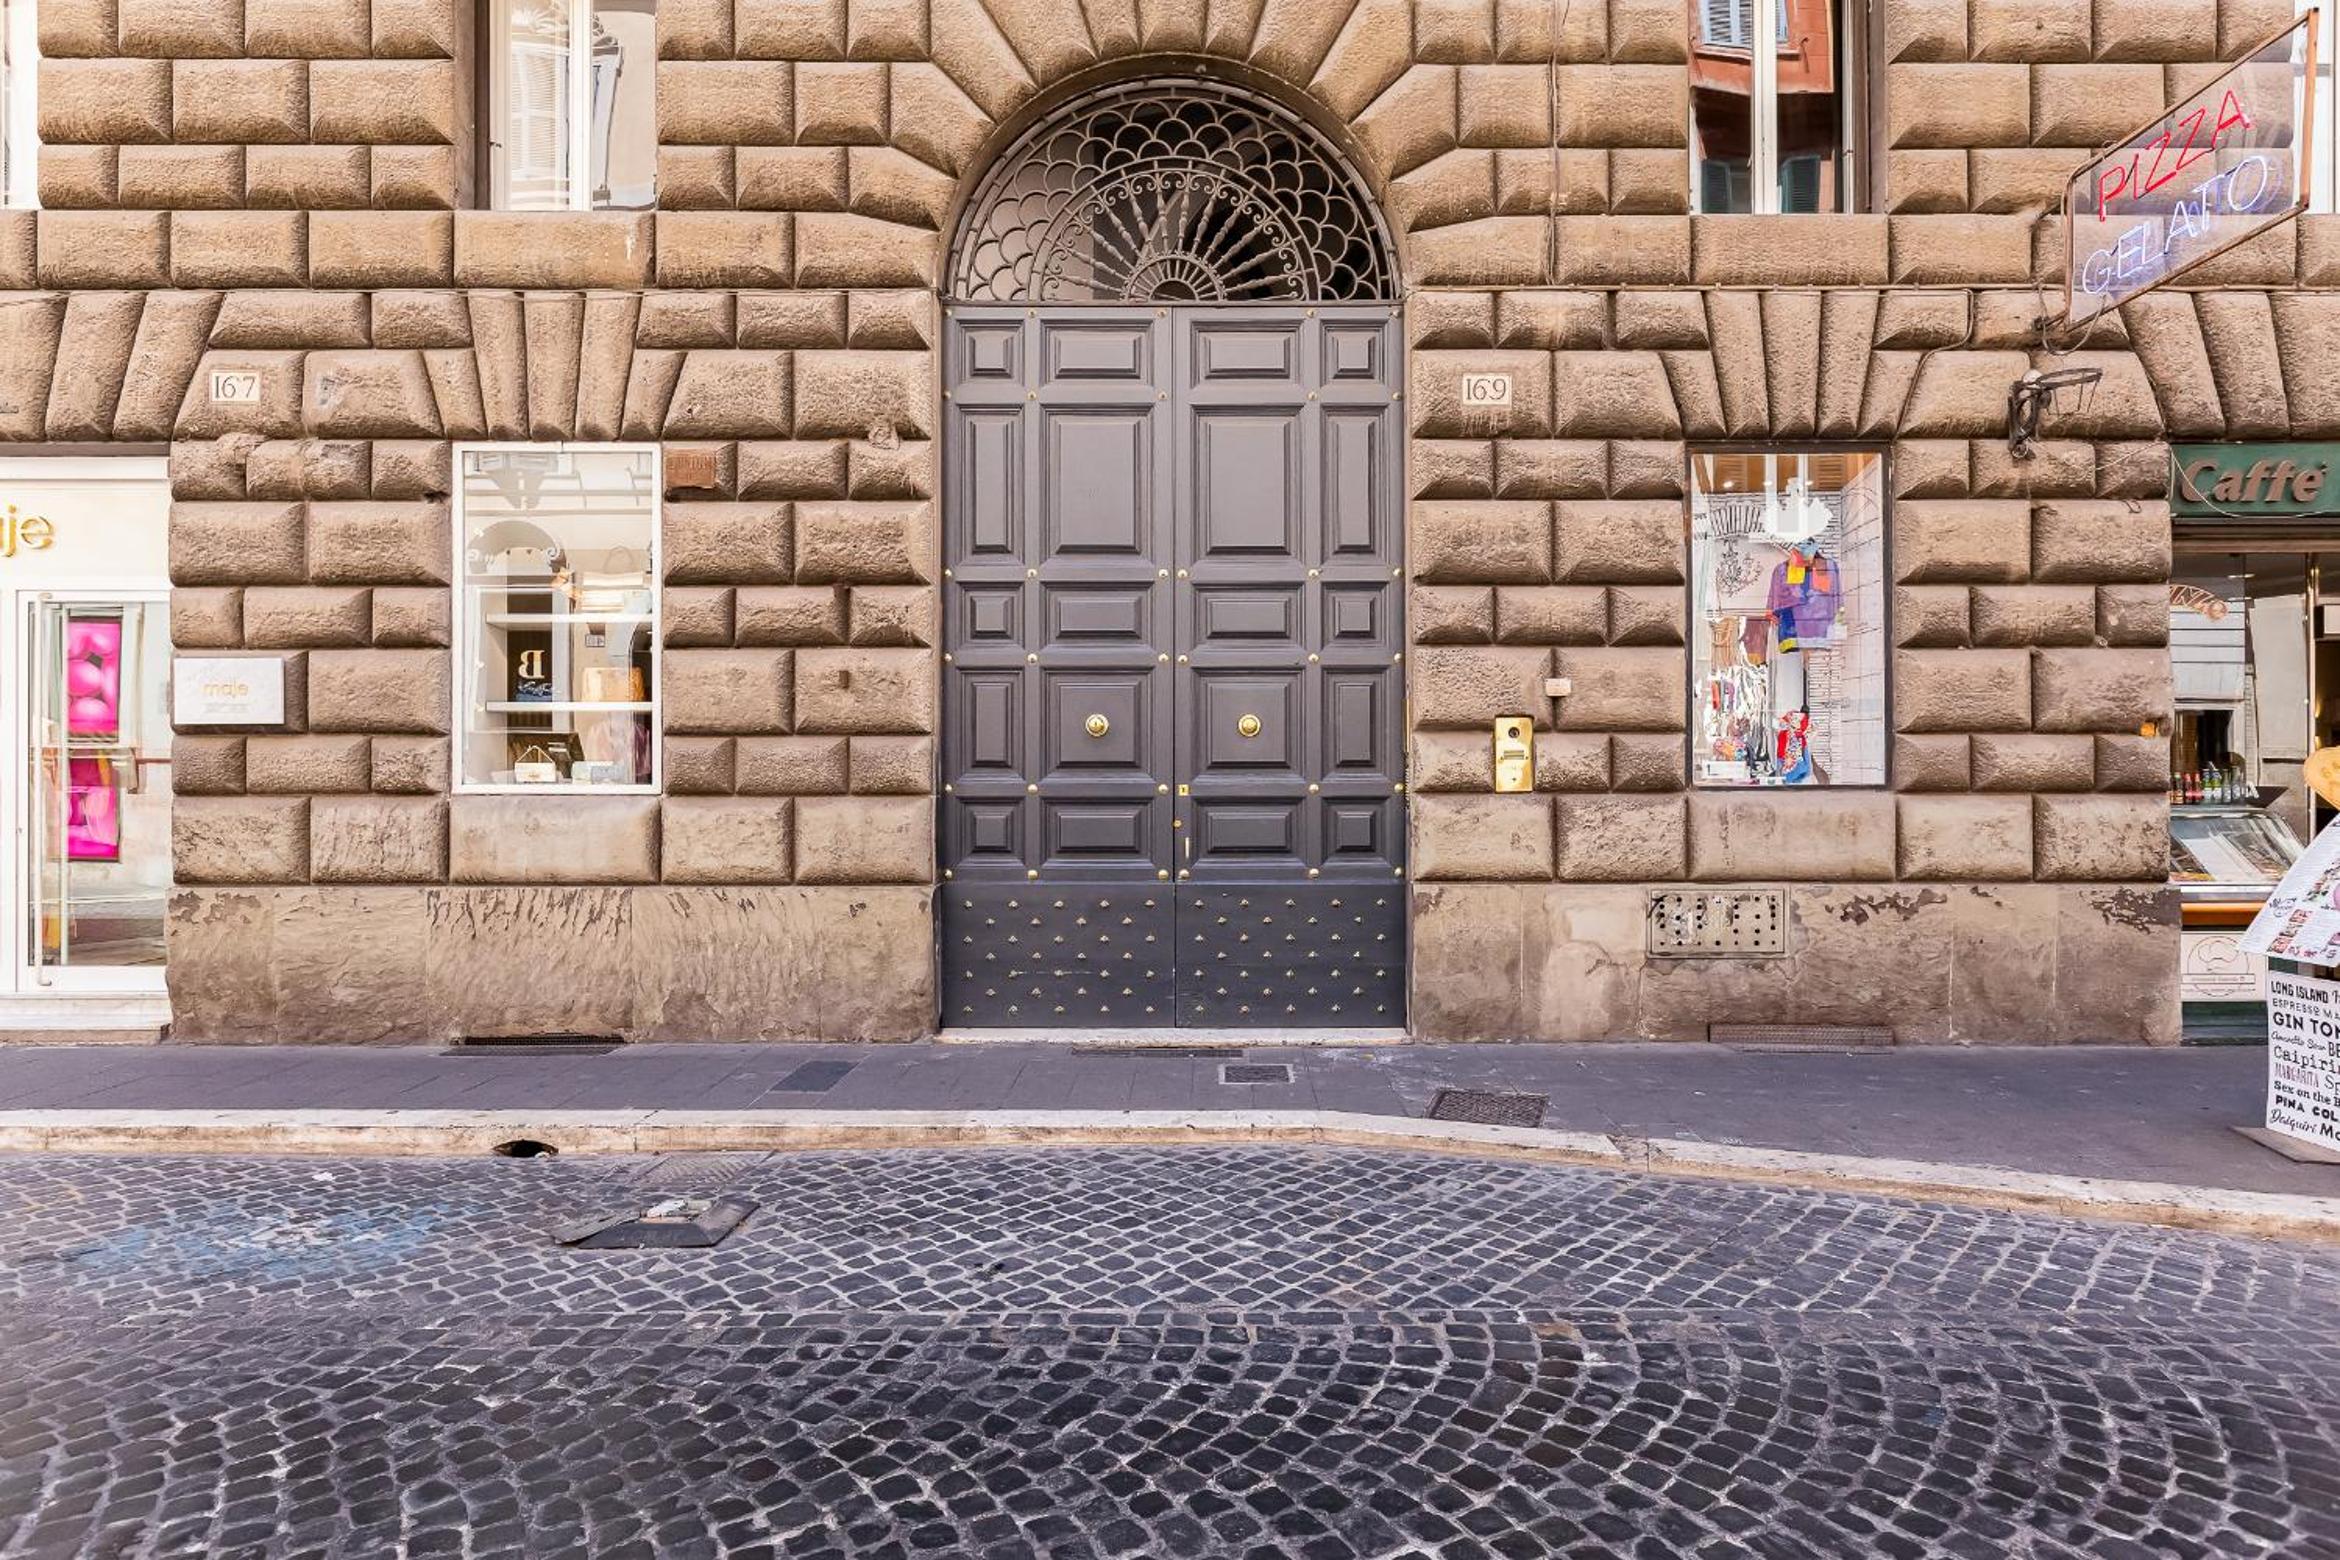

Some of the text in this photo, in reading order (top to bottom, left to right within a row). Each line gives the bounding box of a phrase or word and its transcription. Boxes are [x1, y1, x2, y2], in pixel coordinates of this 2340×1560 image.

[2098, 89, 2251, 223] PIZZA
[2082, 155, 2269, 295] GELATO
[215, 375, 256, 399] 167
[1466, 378, 1506, 401] 169
[0, 503, 55, 558] je
[203, 679, 249, 699] maje
[2271, 980, 2294, 997] LONG
[2295, 985, 2329, 1004] ISLAND
[2272, 998, 2320, 1016] ESPRESSO
[2273, 1011, 2304, 1031] GIN
[2274, 1062, 2319, 1088] MARGARITA
[2274, 1080, 2294, 1094] Sex
[2296, 1089, 2310, 1099] on
[2313, 1091, 2331, 1105] the
